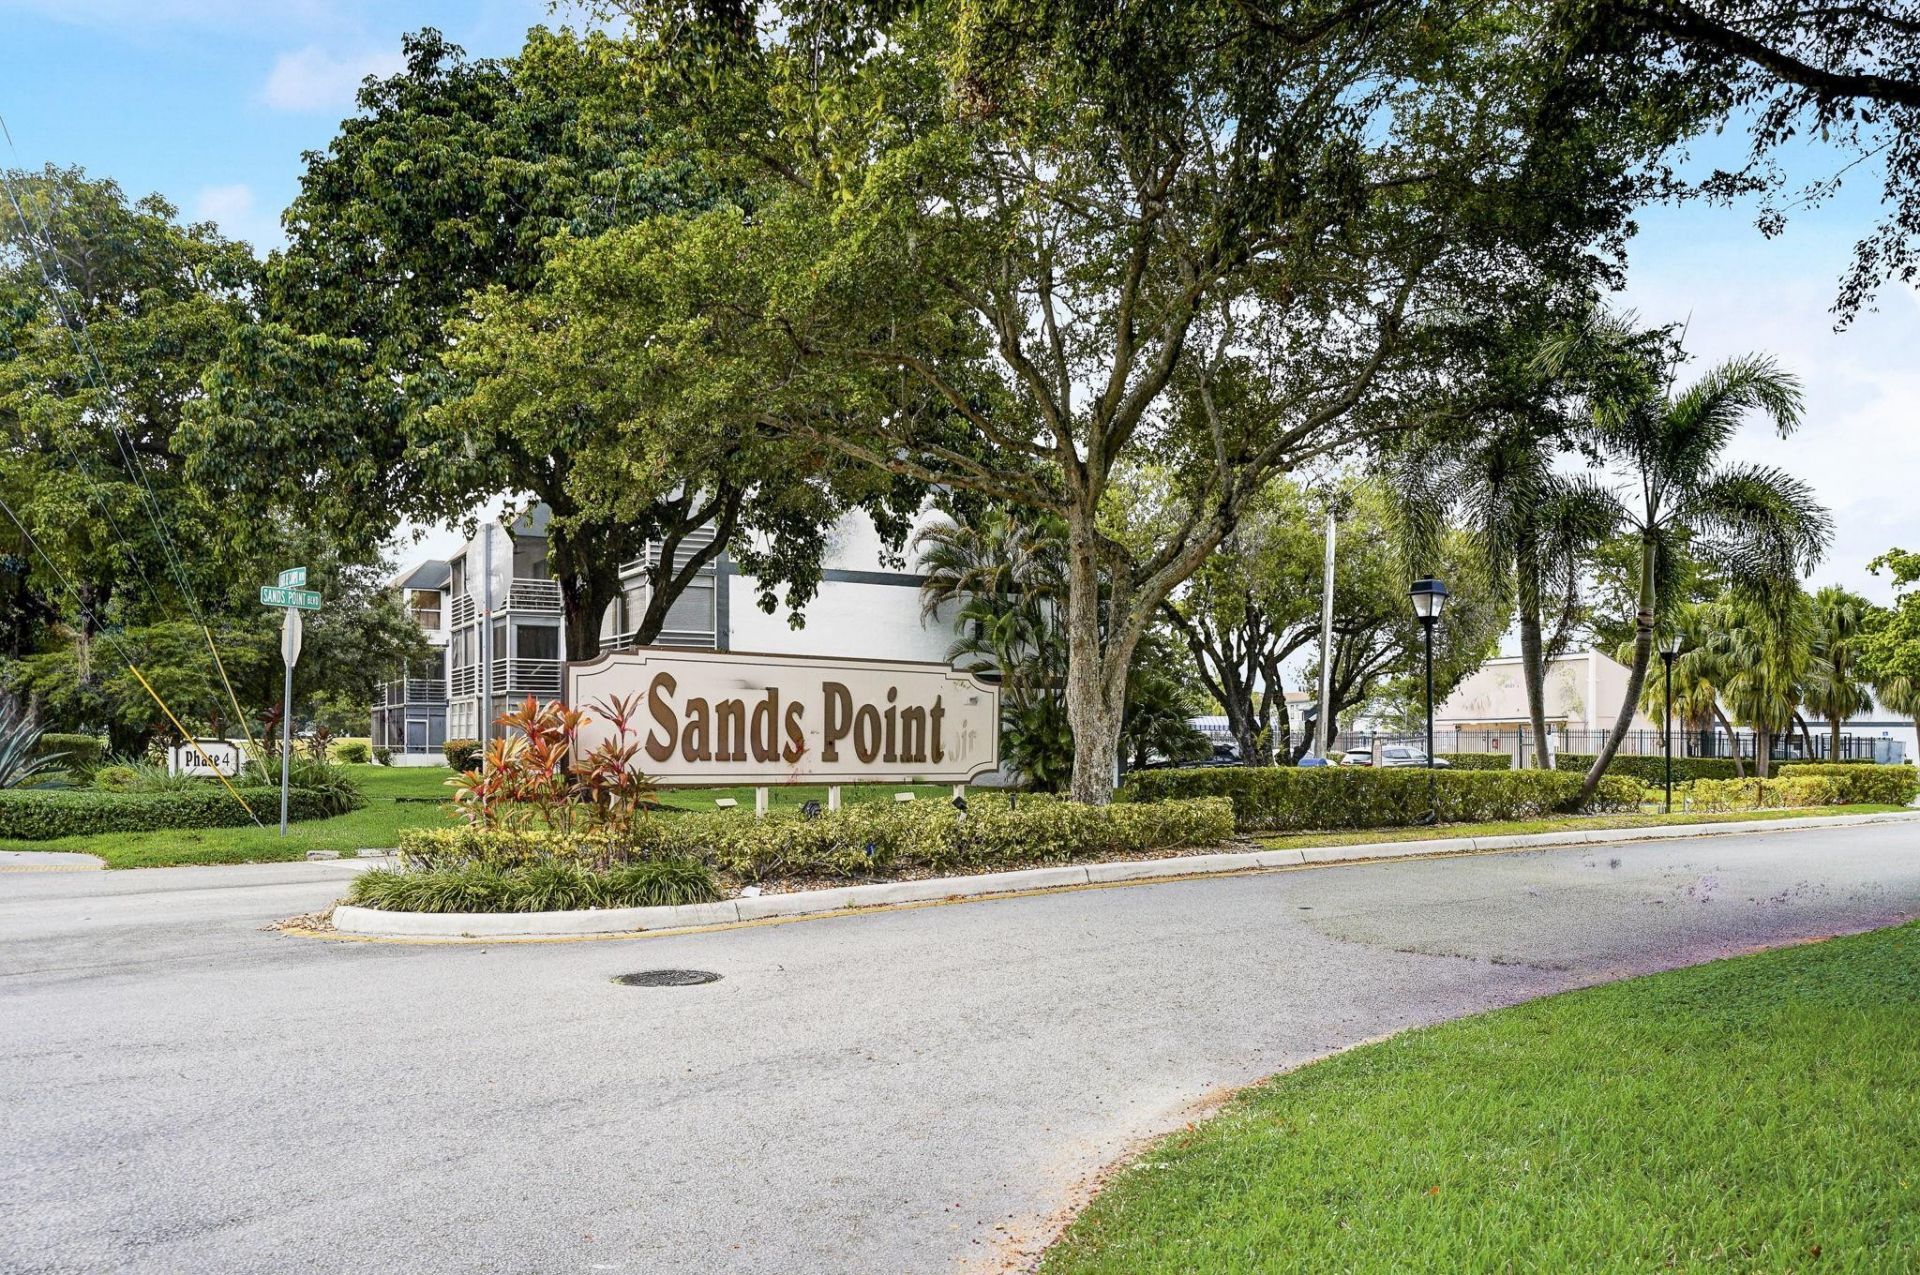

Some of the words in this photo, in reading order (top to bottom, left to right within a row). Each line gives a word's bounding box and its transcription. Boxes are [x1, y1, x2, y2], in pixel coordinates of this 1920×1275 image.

[263, 588, 285, 604] SANDS
[288, 590, 306, 606] POINT
[306, 595, 319, 606] BLVD
[645, 671, 805, 763] Sands
[821, 681, 946, 763] Point
[185, 750, 220, 767] Phase
[222, 752, 230, 767] 4
